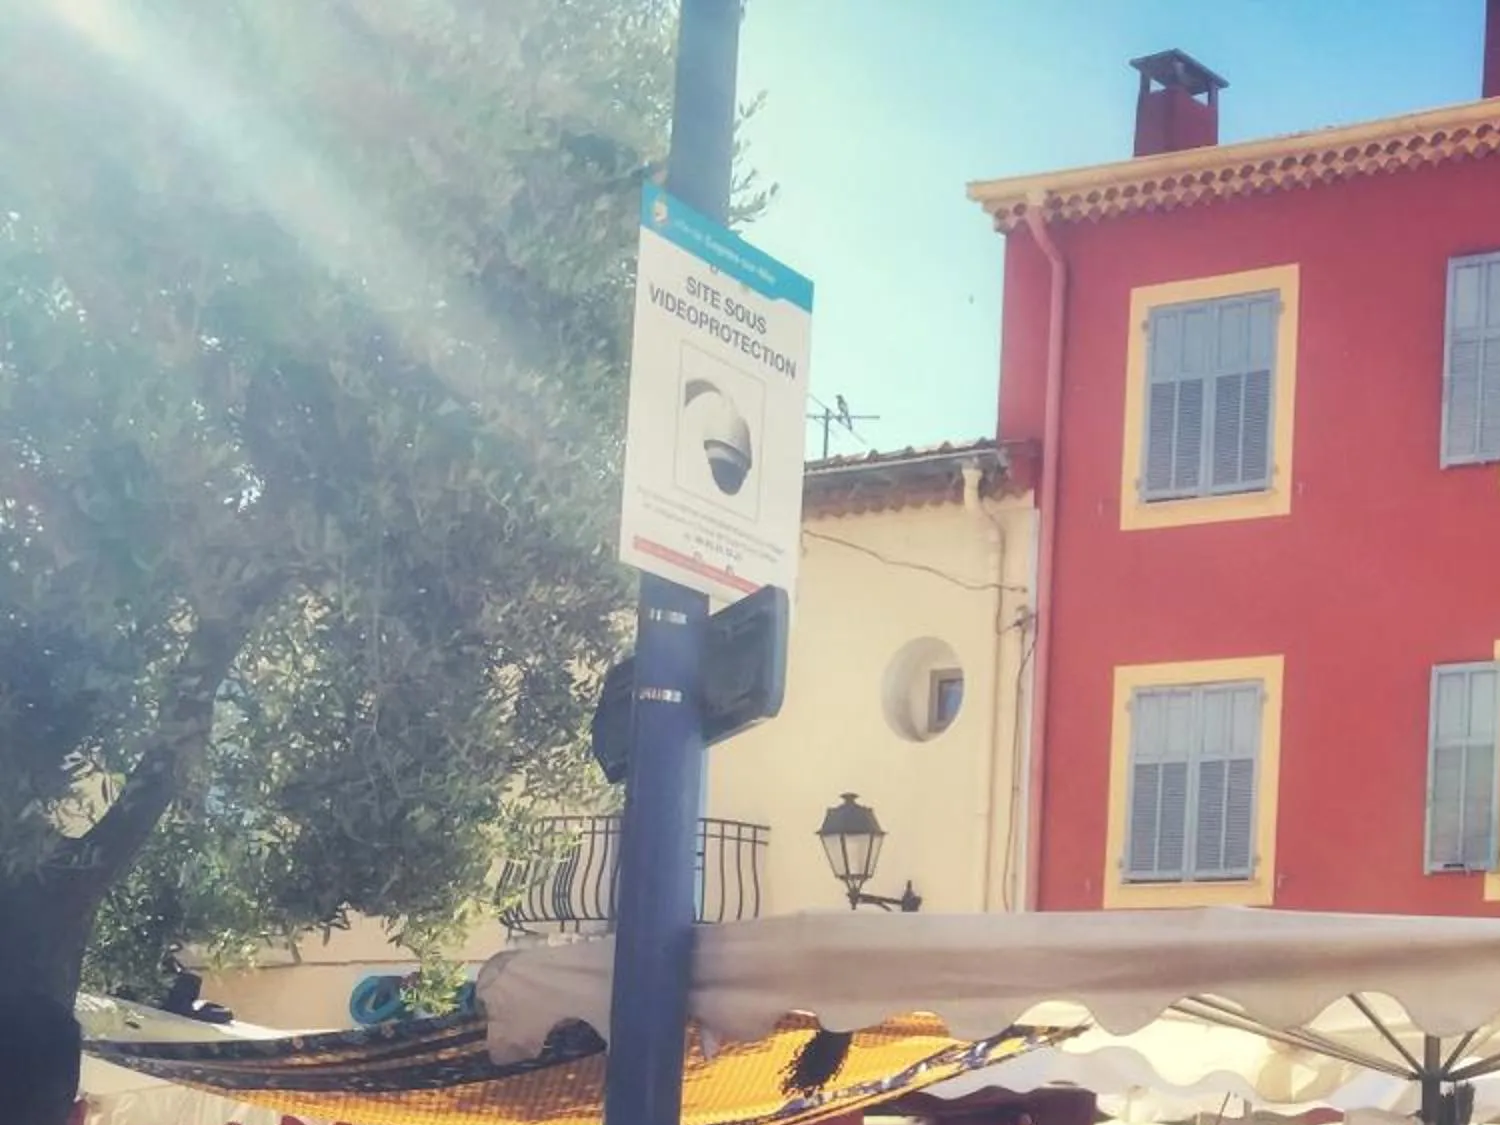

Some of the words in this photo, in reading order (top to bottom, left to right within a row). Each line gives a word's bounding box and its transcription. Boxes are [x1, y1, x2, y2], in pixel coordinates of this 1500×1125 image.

[648, 280, 797, 380] VIDEOPROTECTION
[685, 275, 722, 310] SITE
[724, 297, 767, 335] SOUS
